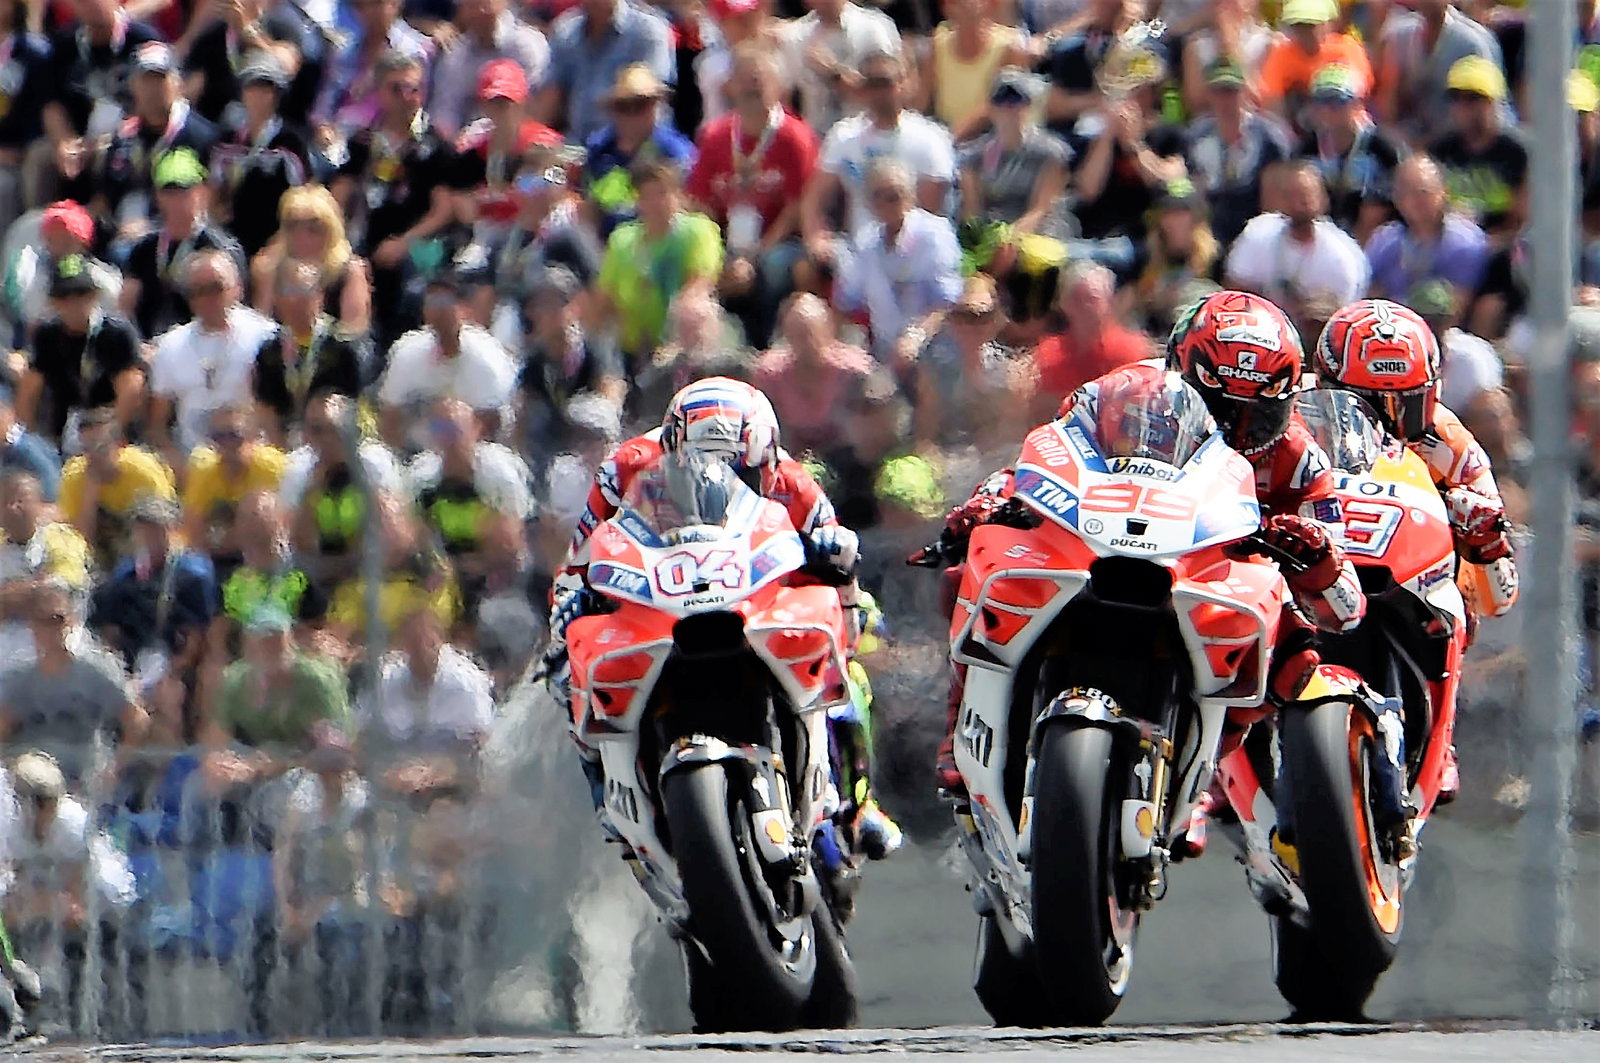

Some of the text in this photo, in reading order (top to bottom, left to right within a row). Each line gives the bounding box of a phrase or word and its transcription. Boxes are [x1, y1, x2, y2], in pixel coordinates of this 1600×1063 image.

[1217, 366, 1271, 382] SHARK
[1032, 479, 1078, 514] TIM
[1110, 538, 1158, 551] DUCATI
[609, 567, 646, 593] TIM
[655, 550, 745, 597] 04
[683, 595, 725, 607] DUCATI
